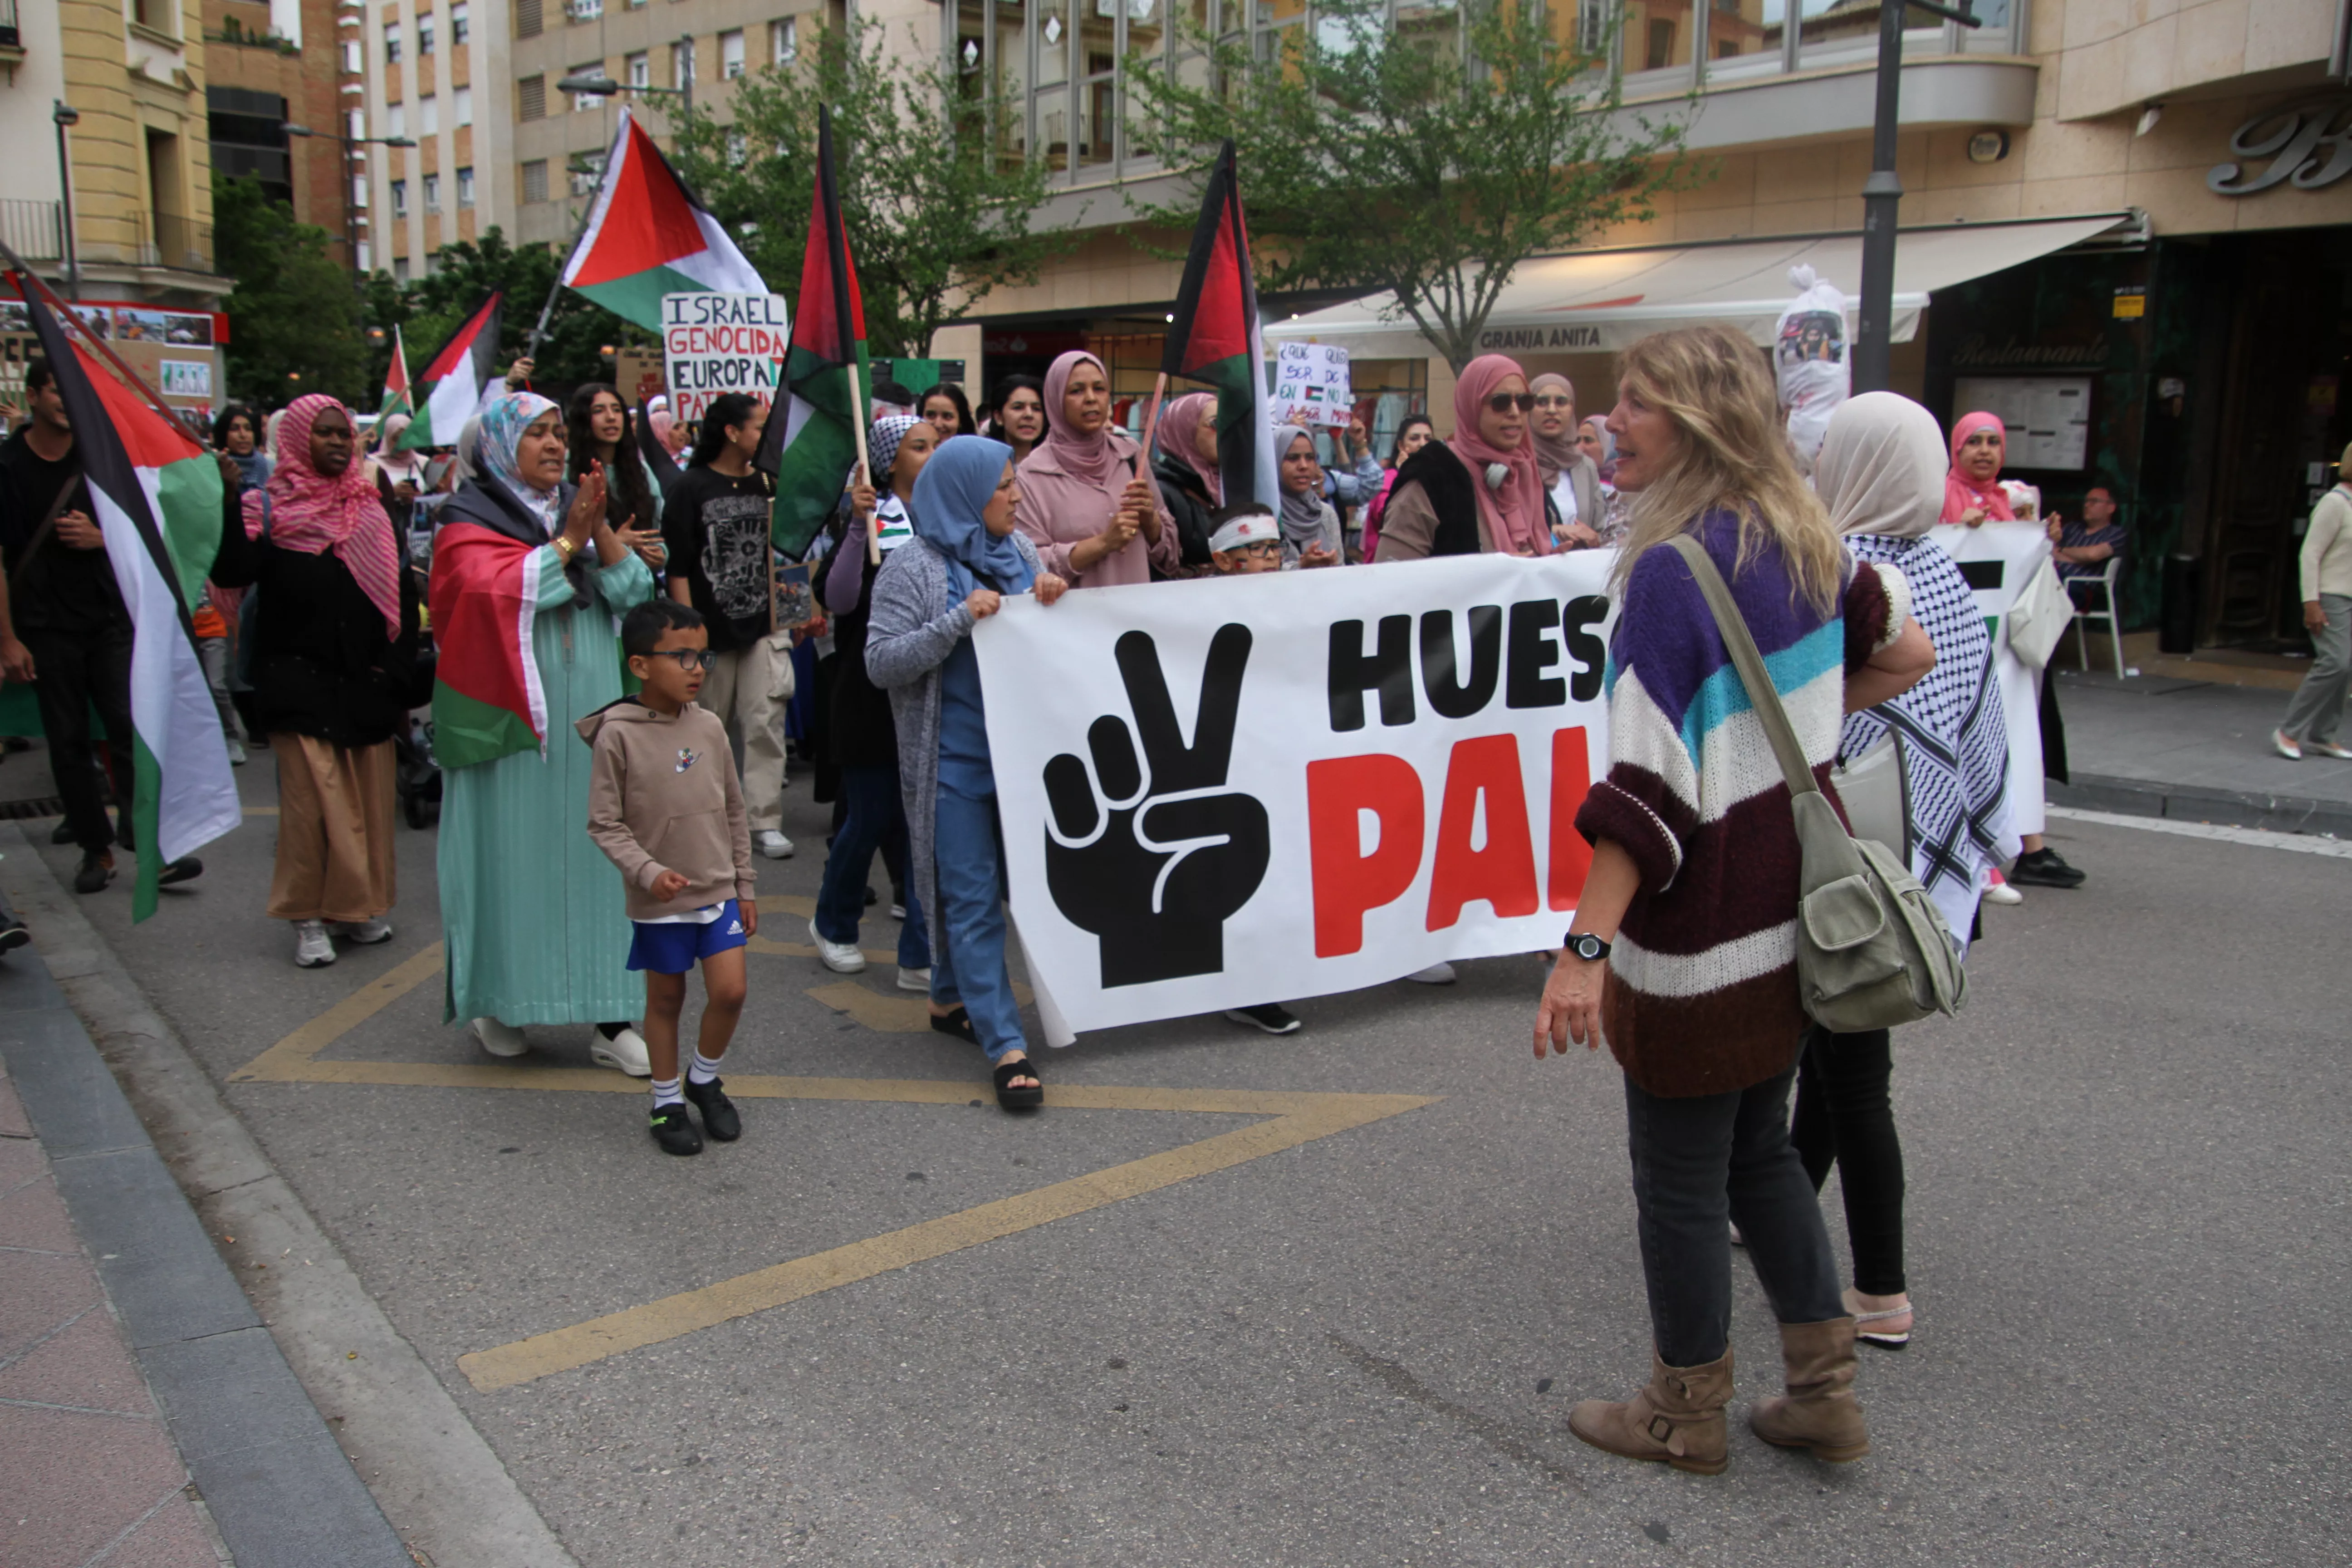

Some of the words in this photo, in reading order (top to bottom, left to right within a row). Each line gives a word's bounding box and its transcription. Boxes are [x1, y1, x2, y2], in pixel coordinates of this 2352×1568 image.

[667, 296, 783, 325] ISRAEL
[669, 325, 786, 355] GENOCIDA
[1480, 328, 1544, 349] GRANJA
[1548, 327, 1600, 347] ANITA
[672, 359, 770, 389] EUROPA
